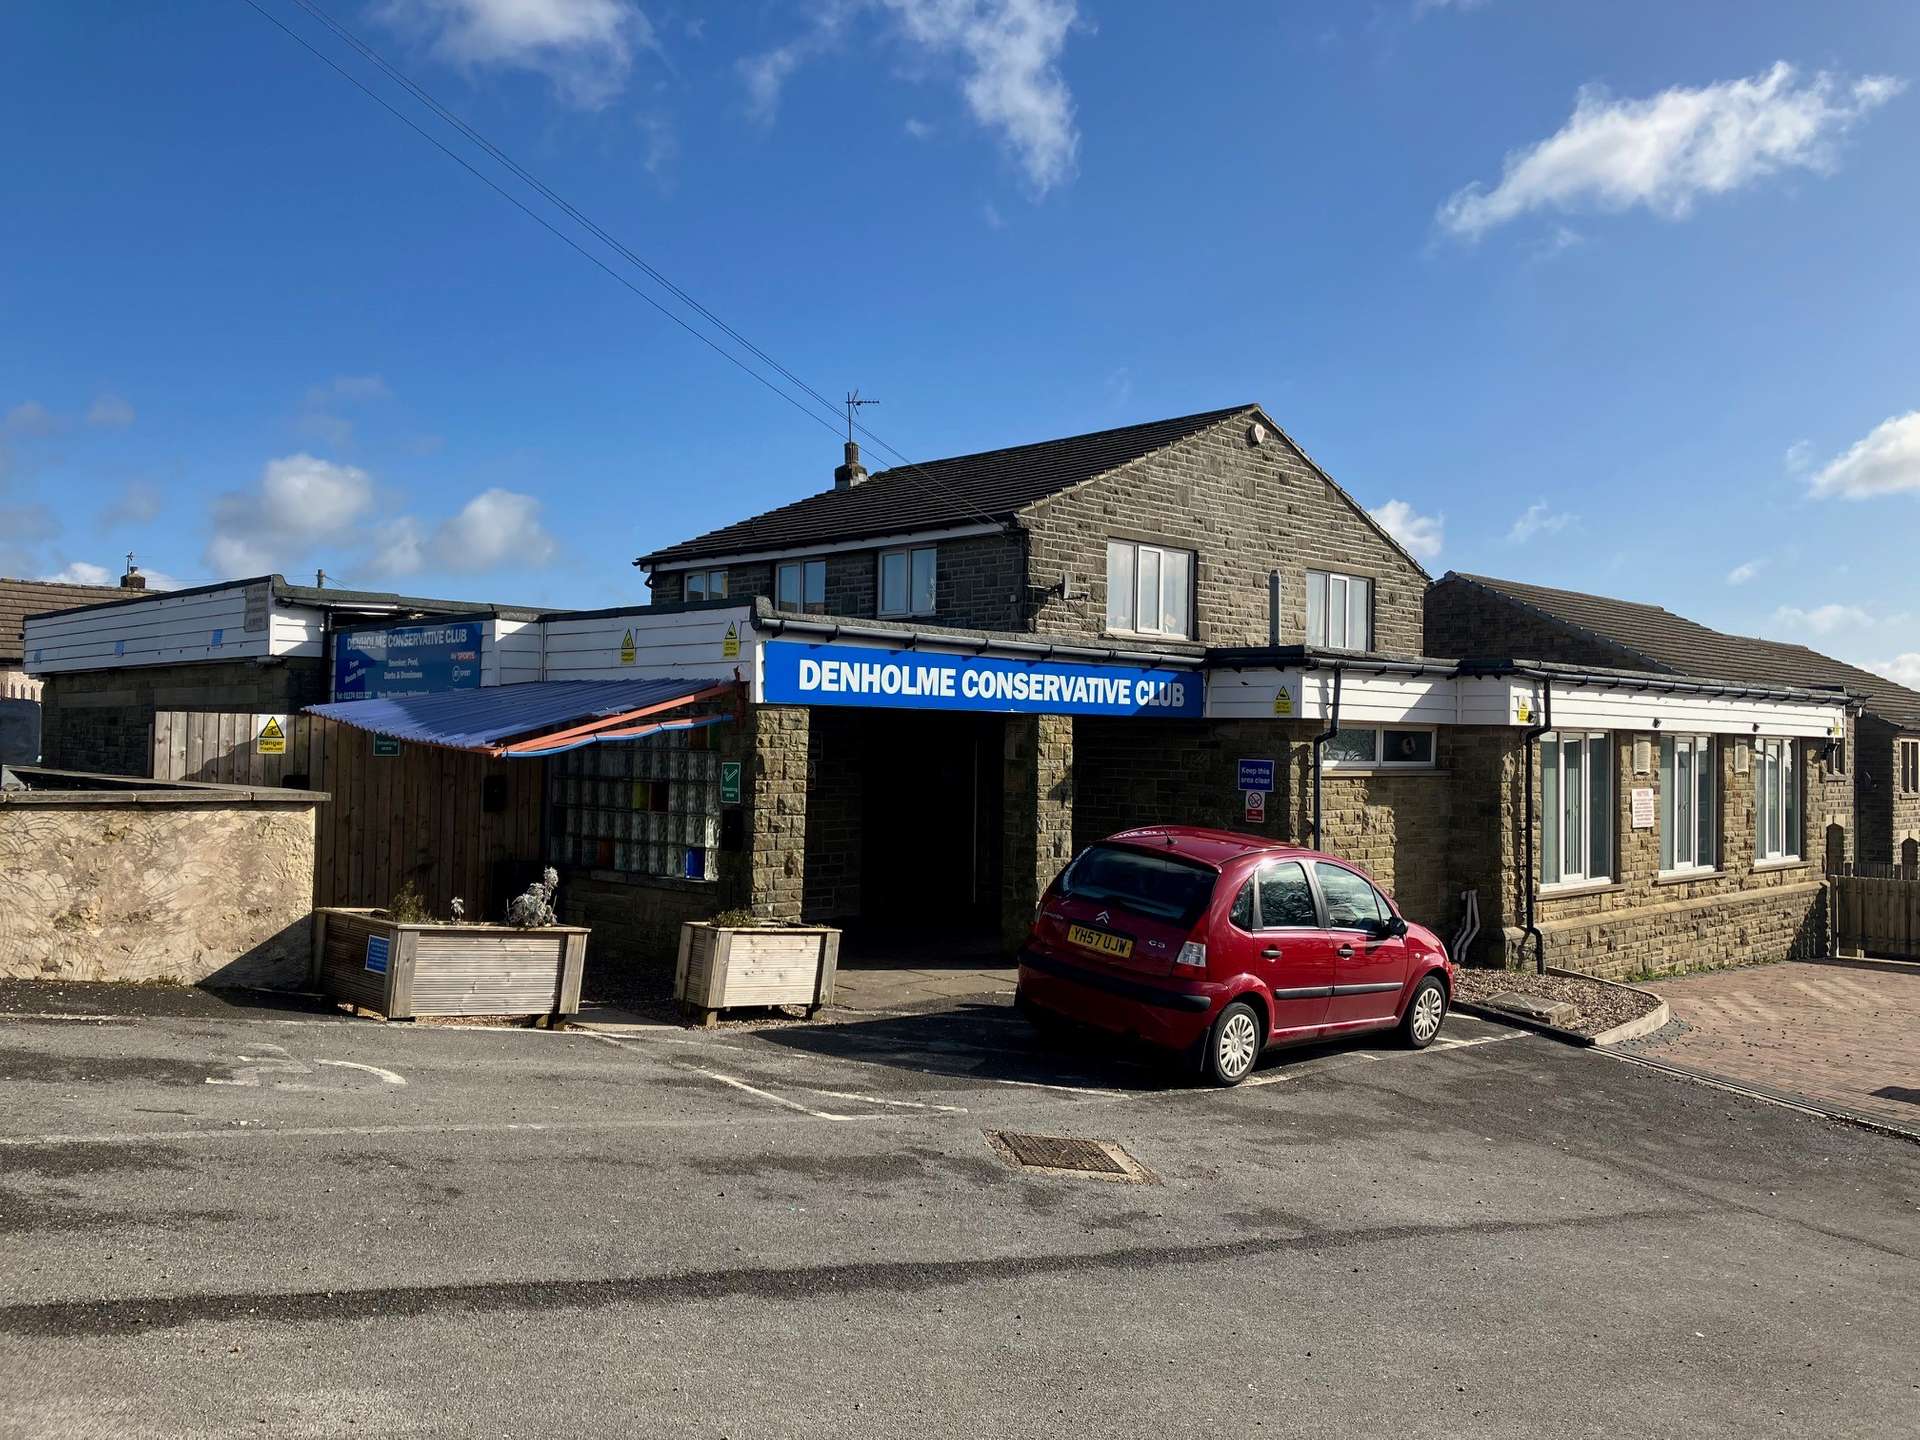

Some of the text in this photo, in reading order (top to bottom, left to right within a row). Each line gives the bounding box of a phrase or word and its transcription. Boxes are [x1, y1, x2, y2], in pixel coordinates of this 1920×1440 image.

[347, 628, 467, 650] DENHOLME CONSERVATIVE CLUB
[799, 659, 1186, 708] DENHOLME CONSERVATIVE CLUB
[259, 739, 283, 747] Danger
[1241, 767, 1270, 775] Keep this
[1074, 927, 1127, 953] YH57 UJW
